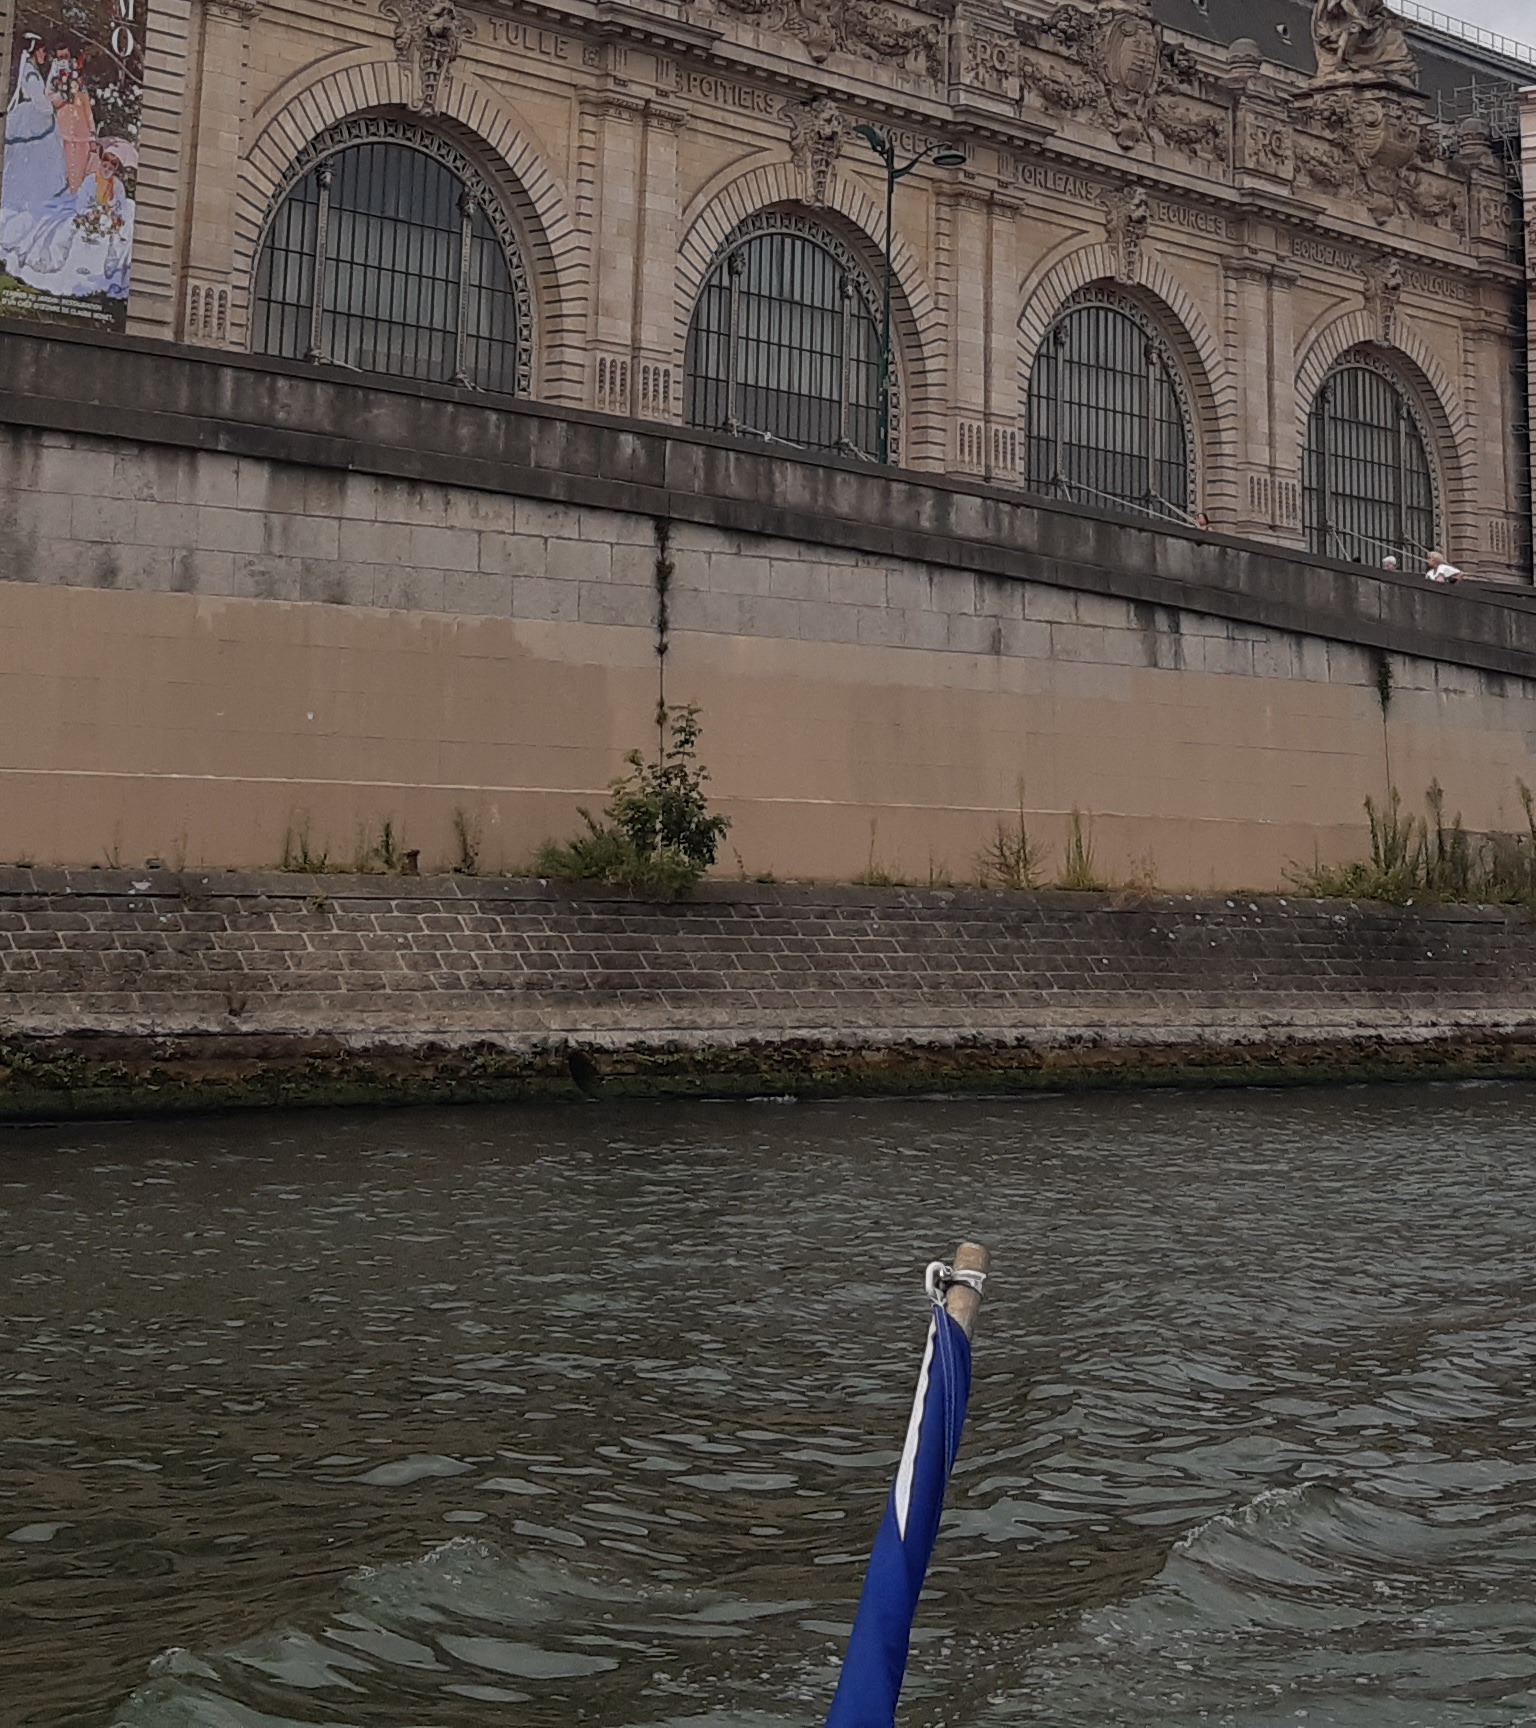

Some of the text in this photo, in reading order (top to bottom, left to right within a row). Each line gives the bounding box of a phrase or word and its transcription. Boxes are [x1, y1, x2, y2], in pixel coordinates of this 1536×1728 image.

[488, 16, 570, 60] TULLE
[686, 72, 774, 116] POITIERS
[1021, 164, 1094, 202] ORLEANS
[1156, 201, 1222, 238] BOURGES
